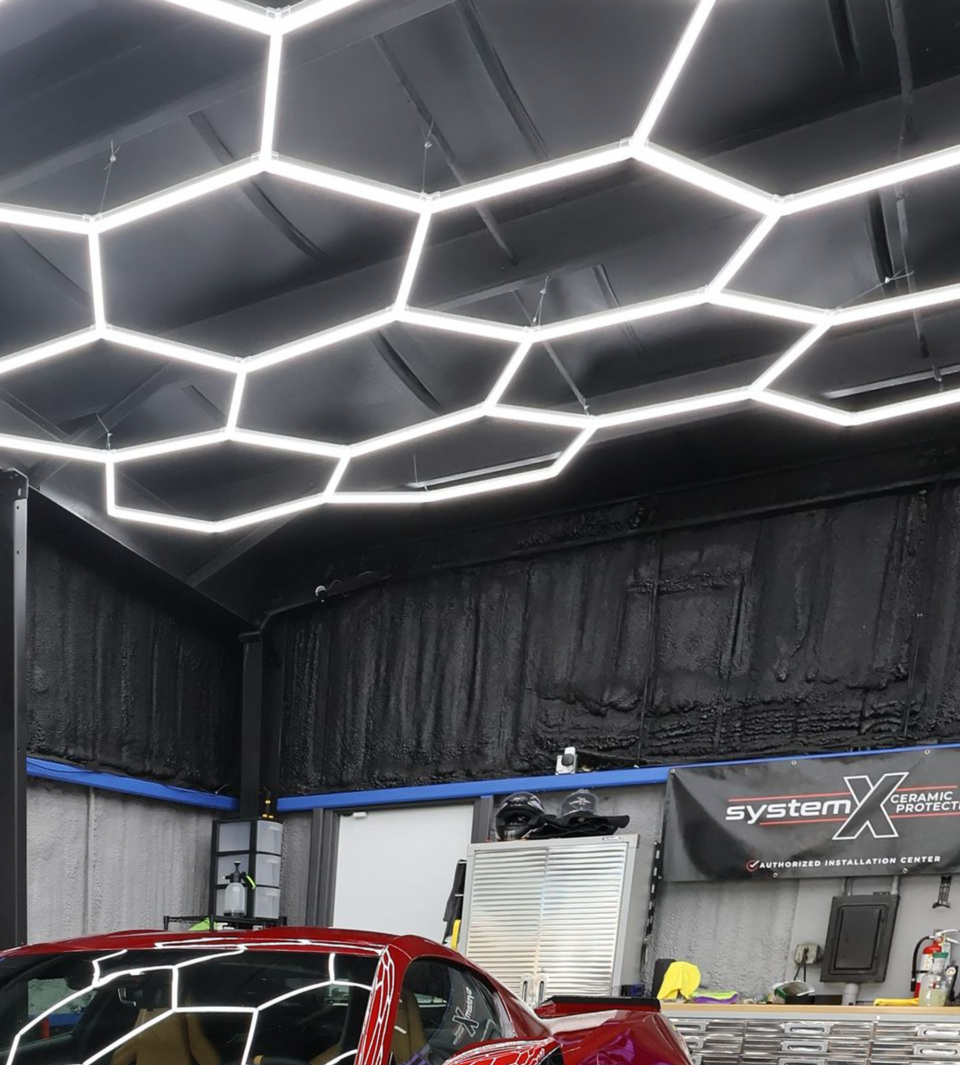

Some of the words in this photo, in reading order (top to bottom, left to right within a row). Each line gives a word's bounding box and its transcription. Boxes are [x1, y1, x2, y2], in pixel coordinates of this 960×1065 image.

[890, 791, 954, 804] CERAMIC
[725, 799, 852, 825] system
[759, 860, 821, 869] AUTHORIZED
[824, 857, 897, 867] INSTALLATION
[900, 855, 941, 865] CENTER
